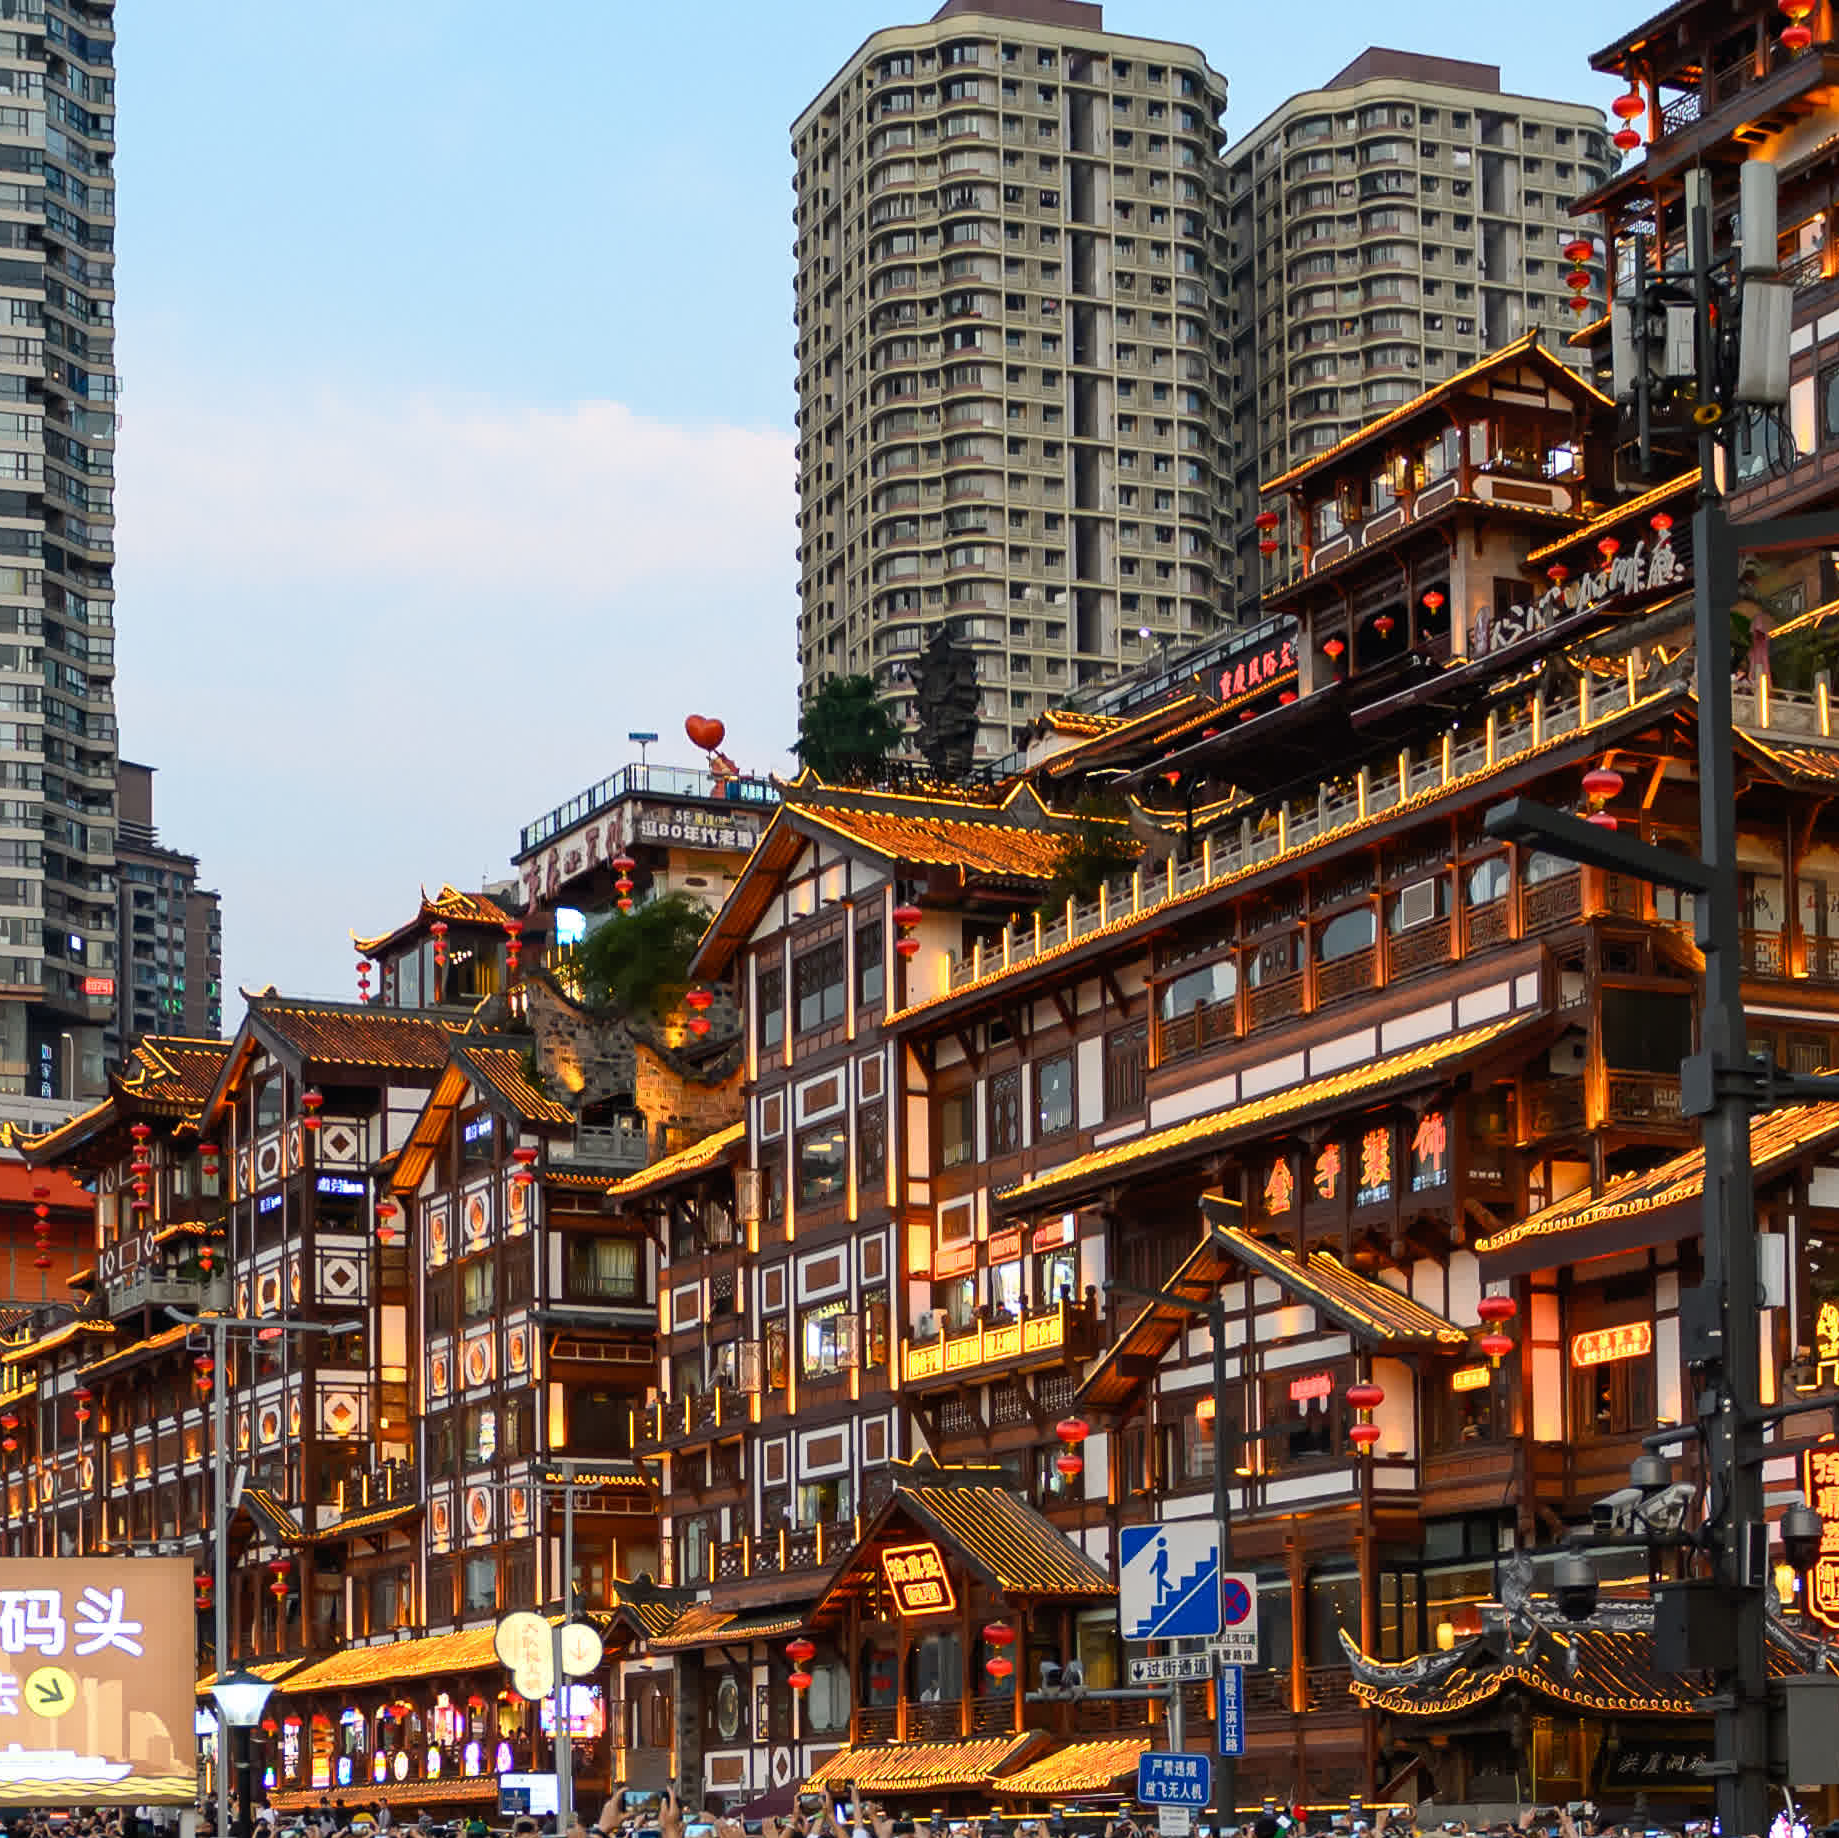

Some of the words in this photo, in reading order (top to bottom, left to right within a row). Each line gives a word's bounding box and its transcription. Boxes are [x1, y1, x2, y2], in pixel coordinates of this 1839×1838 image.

[1147, 1657, 1209, 1678] 过街通道
[1151, 1759, 1198, 1778] 严禁违规
[1145, 1781, 1203, 1800] 放飞无人机
